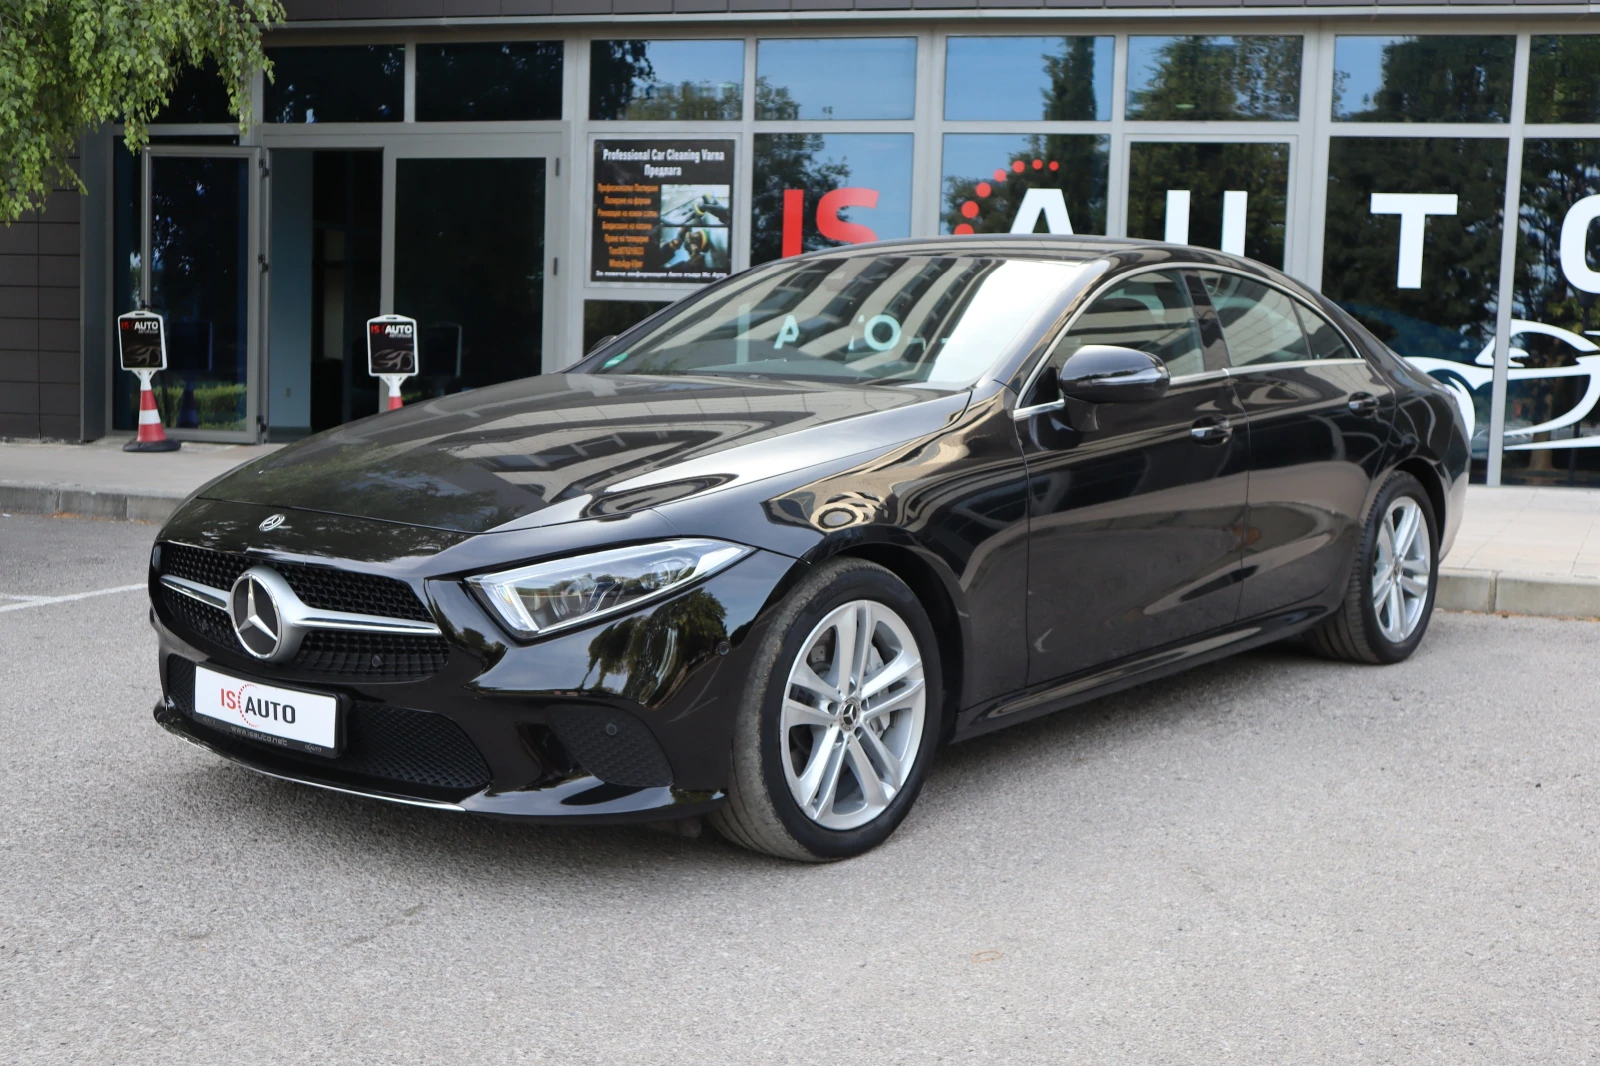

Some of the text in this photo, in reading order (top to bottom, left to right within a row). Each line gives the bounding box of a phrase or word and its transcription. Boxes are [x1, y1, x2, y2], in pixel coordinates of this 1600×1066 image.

[603, 149, 725, 164] Professional Car Cleaning Varna
[121, 321, 159, 330] IS AUTO
[371, 324, 412, 334] IS AUTO
[221, 688, 296, 724] IS AUTO
[231, 726, 288, 747] www.isauto.net
